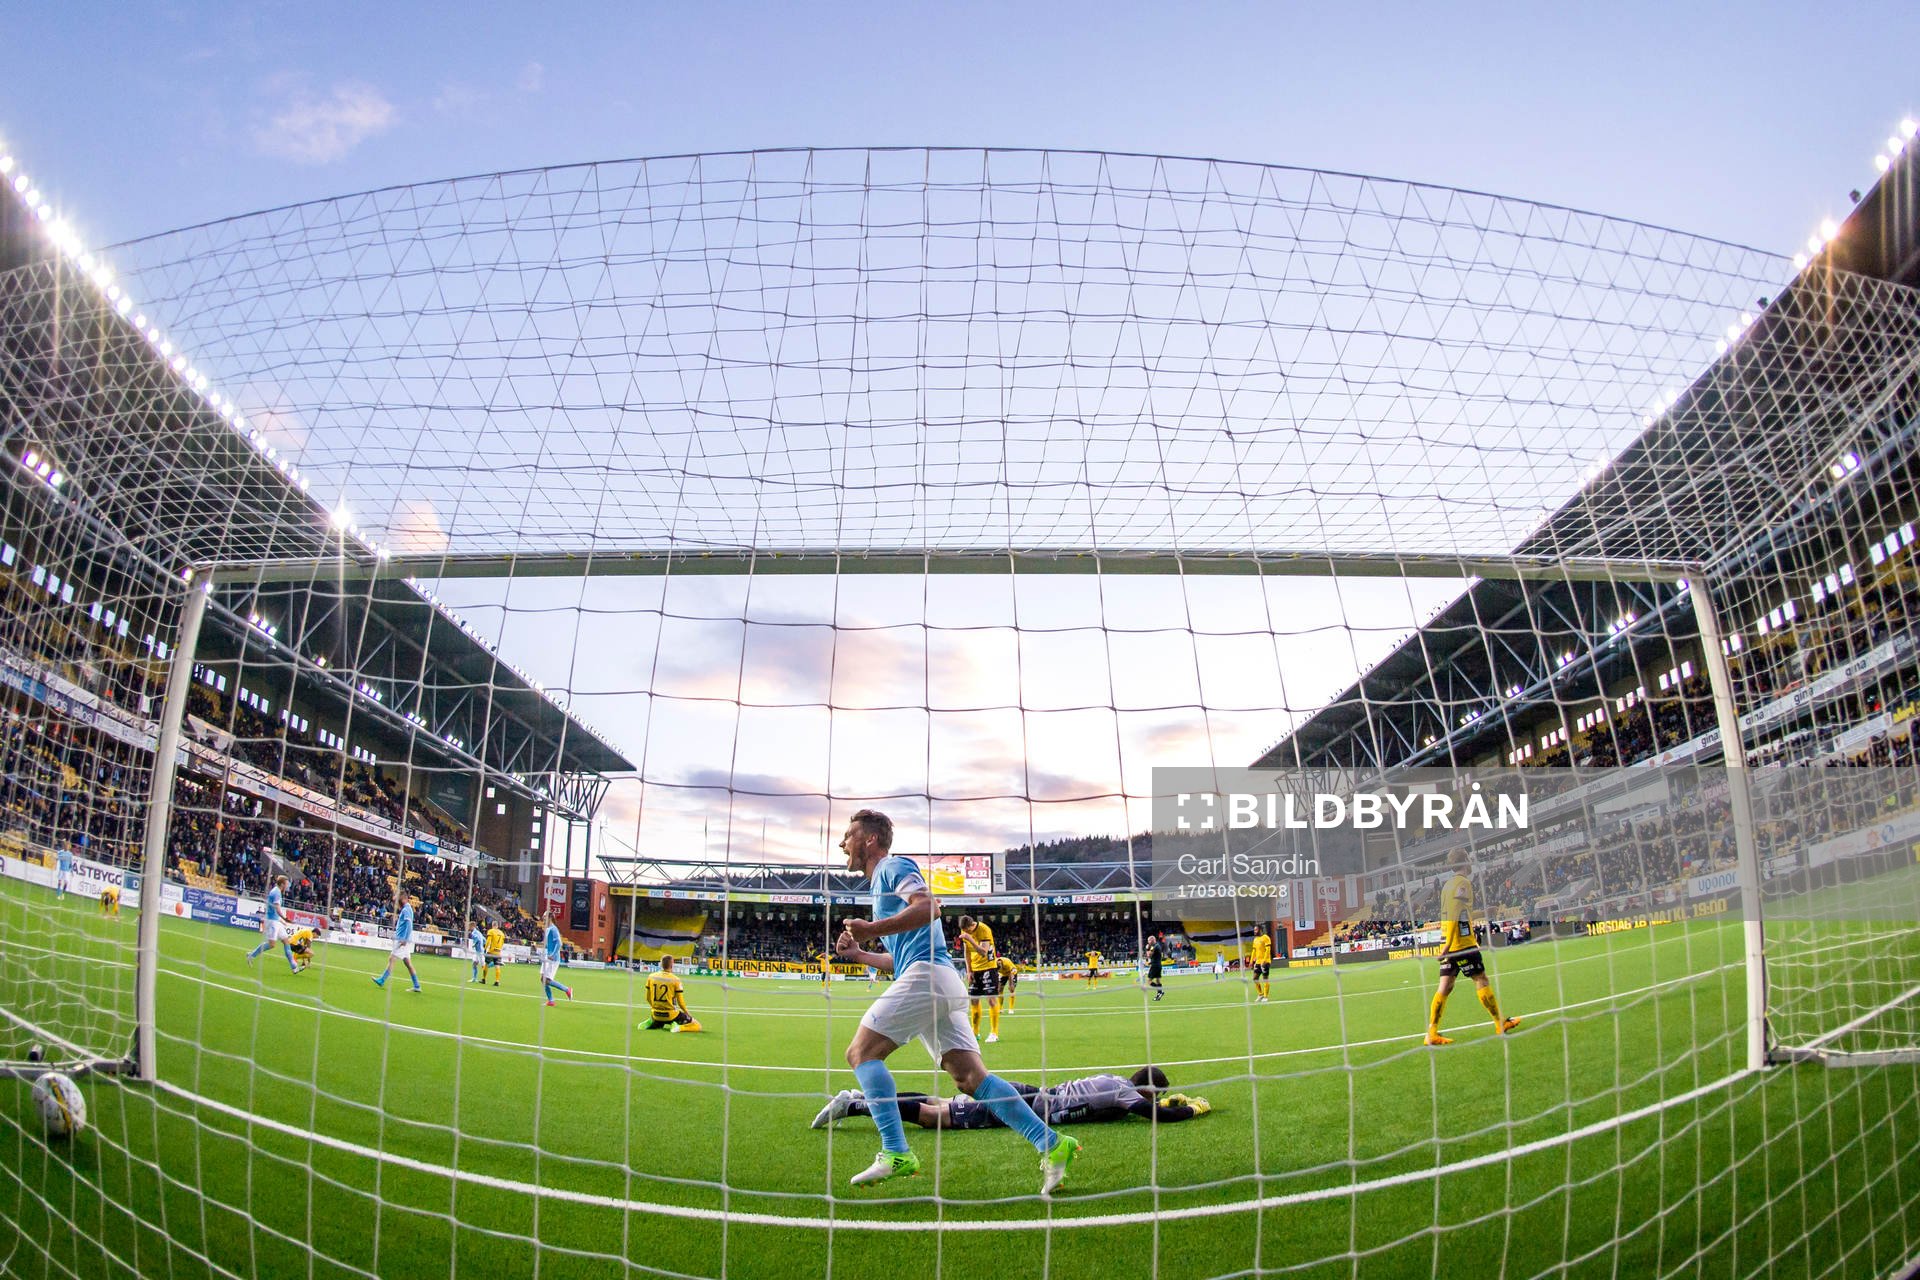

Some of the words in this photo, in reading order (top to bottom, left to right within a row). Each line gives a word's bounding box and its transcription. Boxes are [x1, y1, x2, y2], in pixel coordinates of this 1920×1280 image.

[71, 860, 122, 886] ÄSTBYGG
[230, 915, 260, 929] Caverion
[496, 934, 502, 943] 7
[653, 984, 669, 1002] 12
